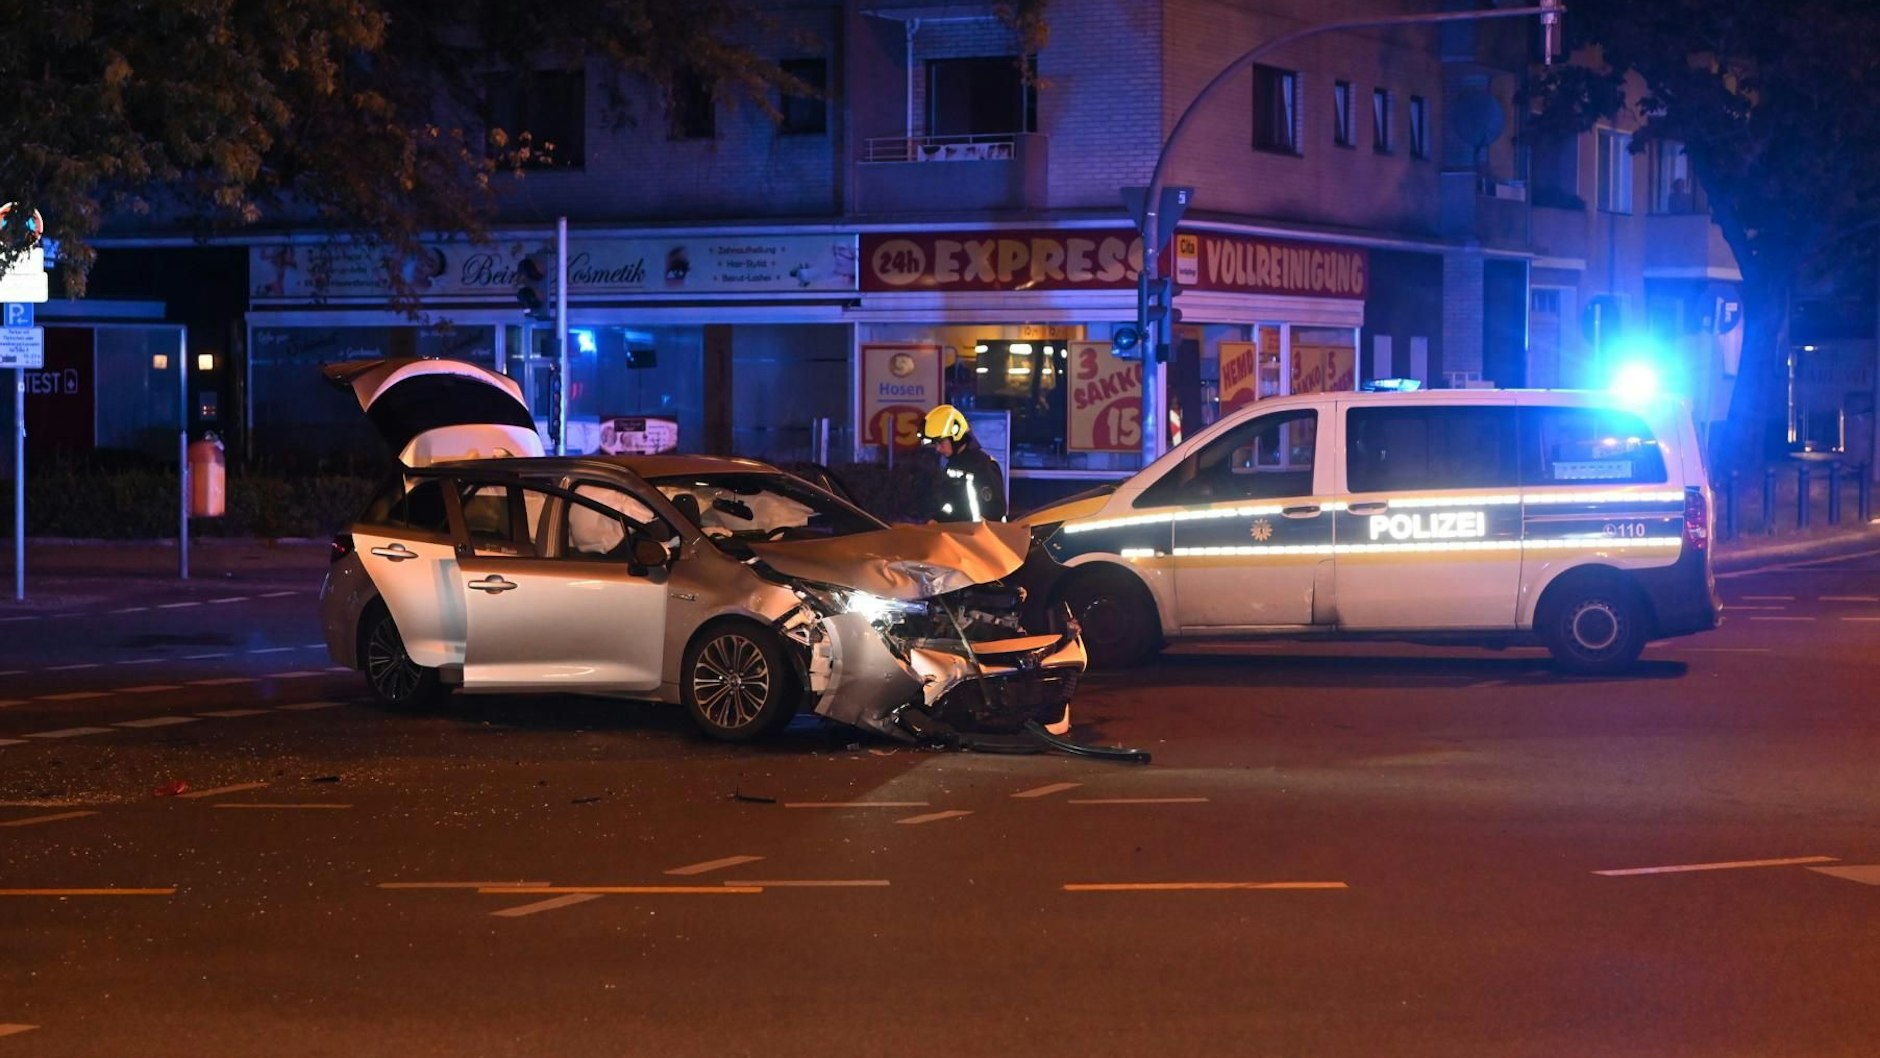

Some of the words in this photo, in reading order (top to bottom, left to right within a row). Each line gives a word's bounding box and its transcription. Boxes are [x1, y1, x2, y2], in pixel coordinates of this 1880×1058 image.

[880, 251, 921, 274] 24h
[1206, 239, 1364, 294] VOLLREINIGUNG
[8, 304, 25, 325] P
[1077, 347, 1099, 380] 3
[1222, 349, 1254, 392] HEMD
[1292, 351, 1302, 380] 3
[1327, 351, 1336, 379] 5
[25, 371, 61, 394] TEST
[878, 383, 925, 396] Hosen
[1107, 407, 1142, 446] 15
[1370, 512, 1485, 540] POLIZEI
[1617, 523, 1645, 537] 110
